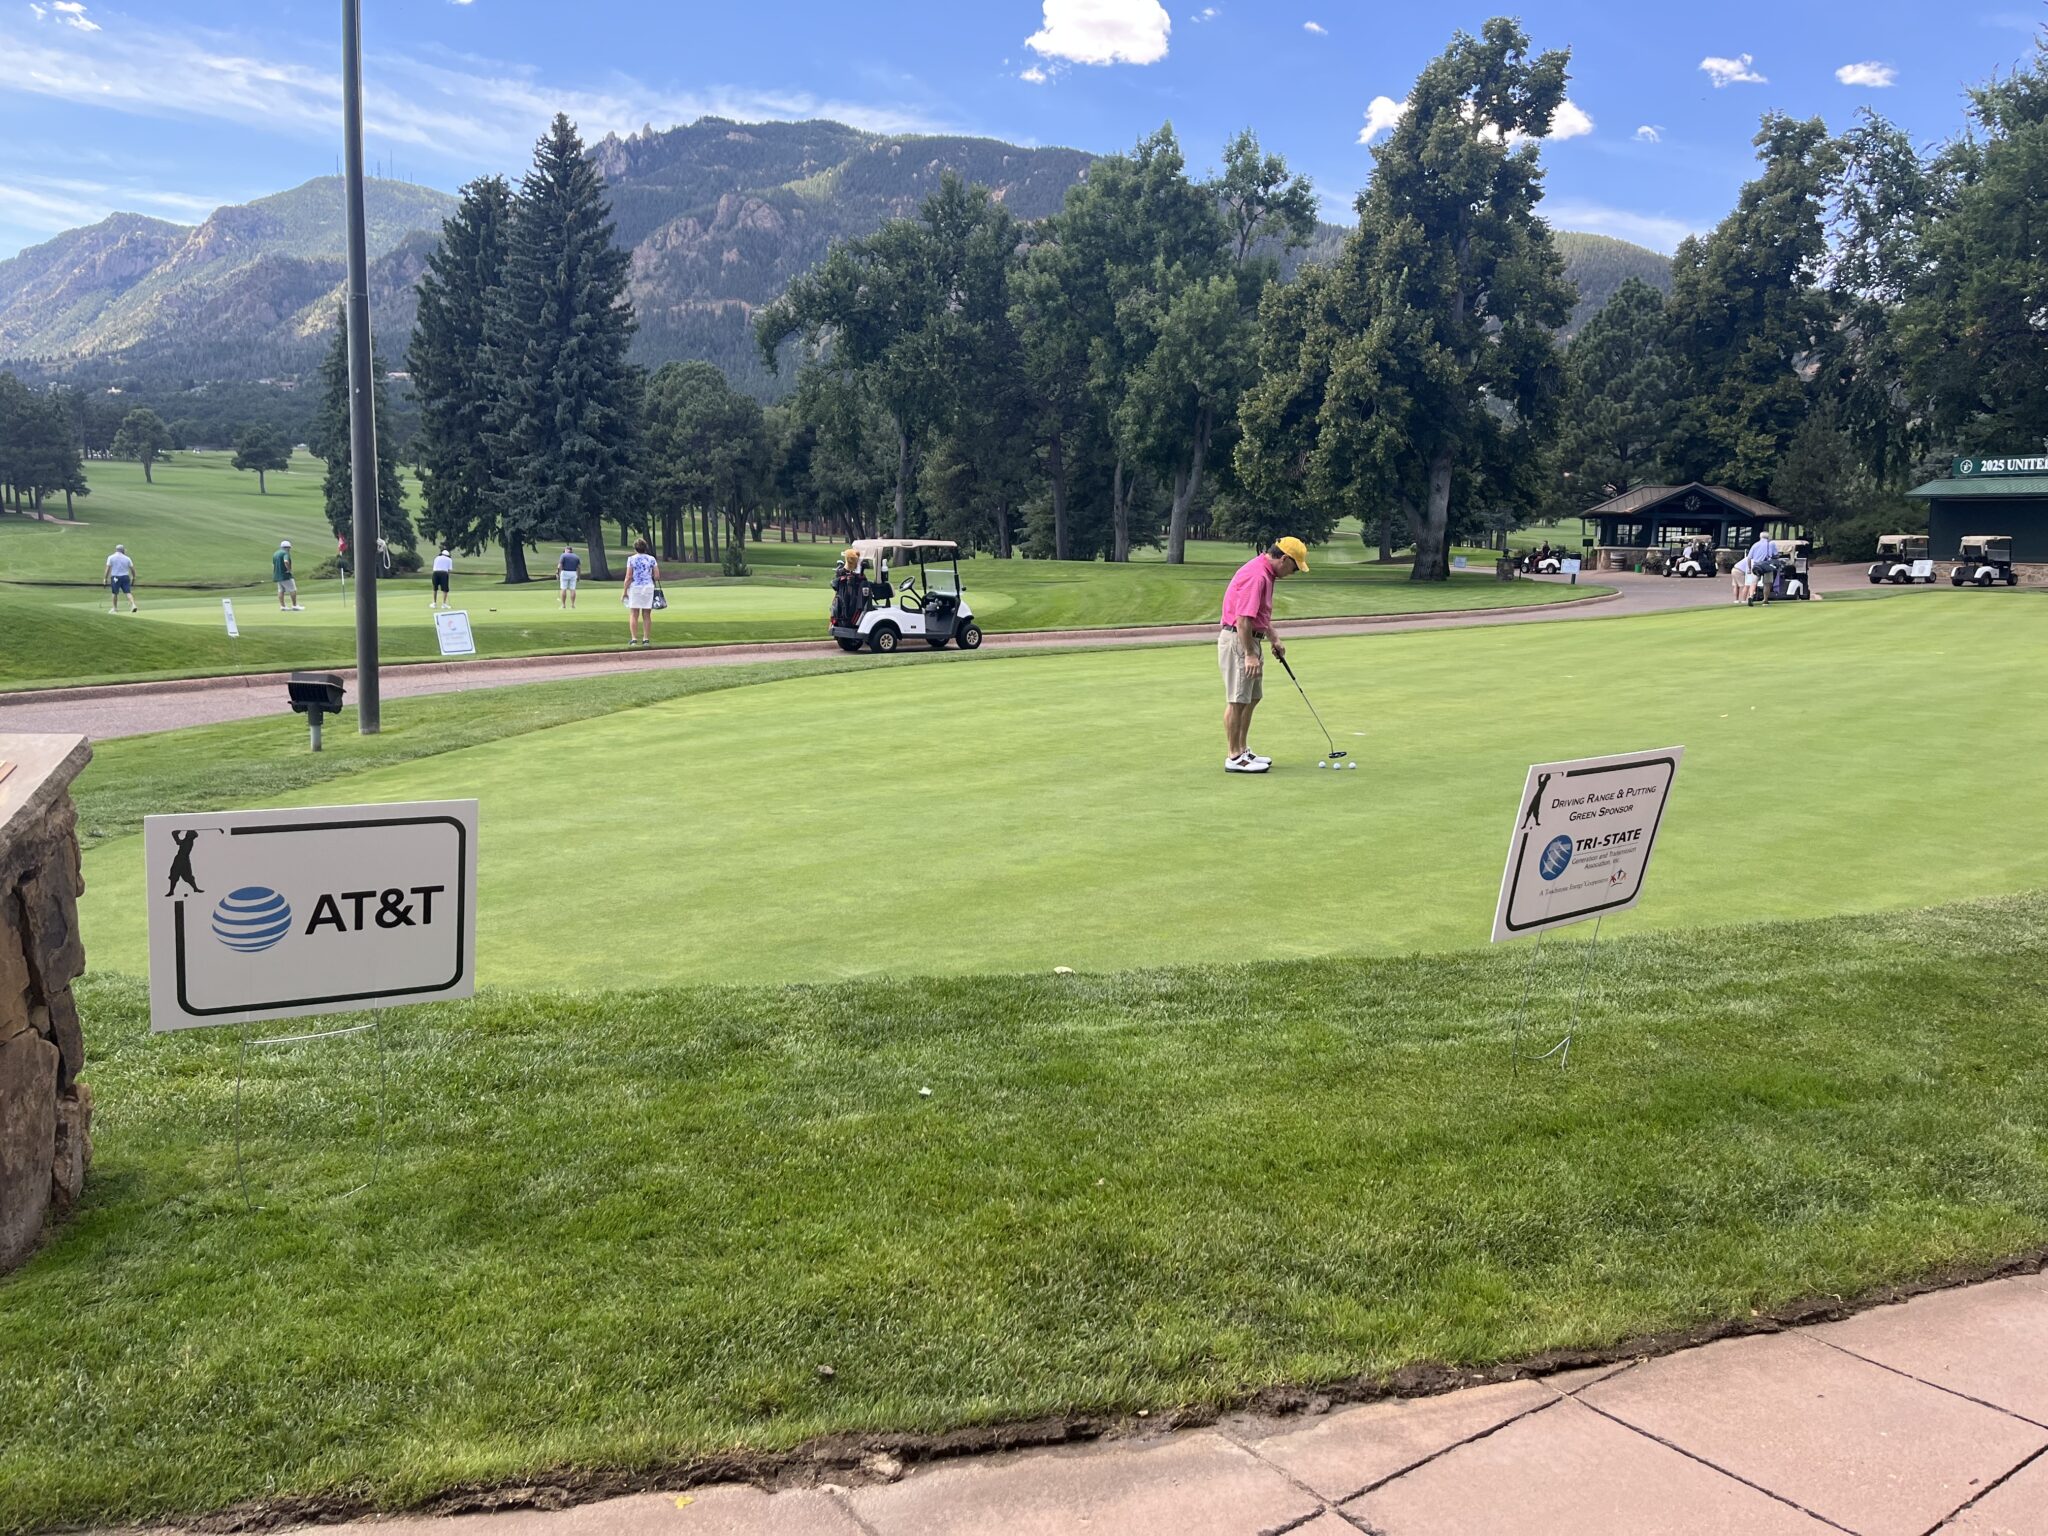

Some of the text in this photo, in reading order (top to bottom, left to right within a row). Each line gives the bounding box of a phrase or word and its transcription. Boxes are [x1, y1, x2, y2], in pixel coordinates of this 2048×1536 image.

[1981, 460, 2005, 471] 2025
[1551, 785, 1657, 809] DRIVING RANGE & PUTTING
[1569, 804, 1634, 822] GREEN SPONSOR
[1576, 828, 1642, 851] TRI-STATE
[304, 884, 445, 936] AT&T
